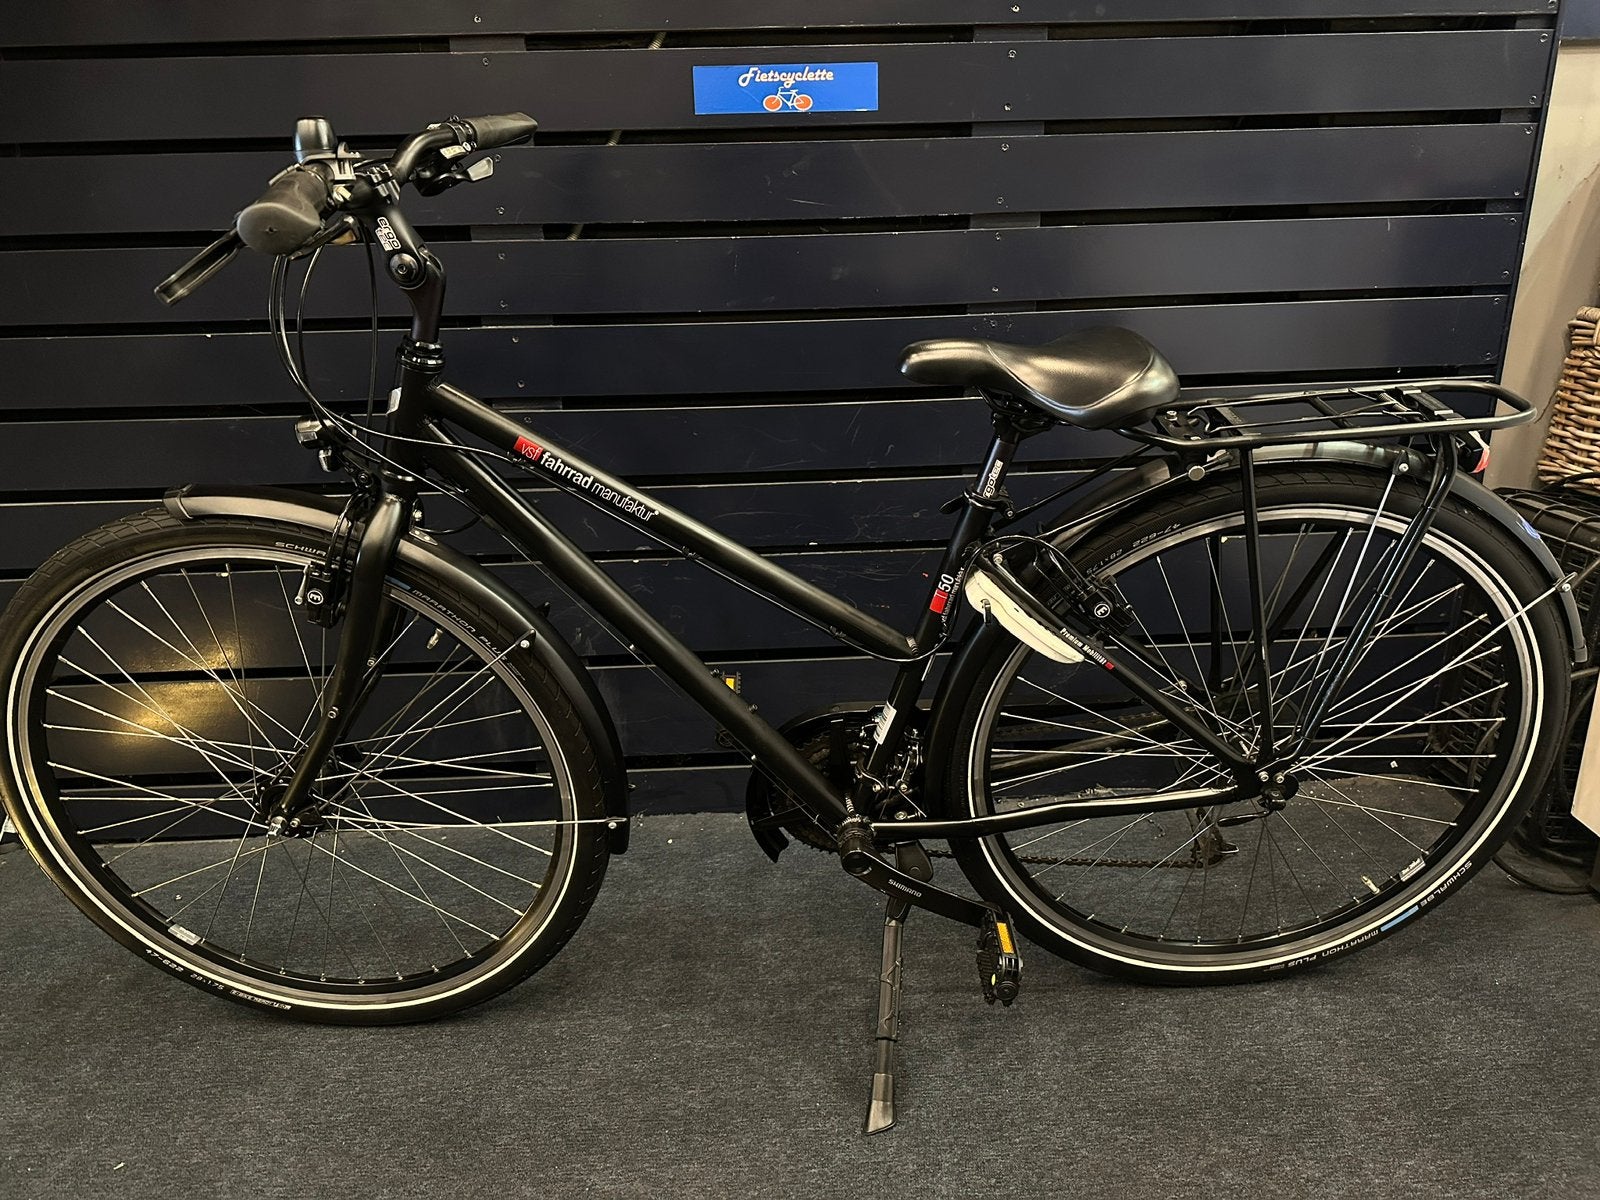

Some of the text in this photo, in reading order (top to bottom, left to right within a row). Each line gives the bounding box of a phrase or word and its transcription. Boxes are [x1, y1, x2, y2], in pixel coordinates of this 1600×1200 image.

[738, 66, 835, 88] Fietscyclette
[377, 216, 402, 249] ergo
[521, 443, 656, 522] vsf fahrrad manufaktur
[983, 459, 1004, 498] rgotec
[275, 541, 327, 557] SCHWA
[412, 589, 477, 633] MARATHON
[1060, 627, 1084, 648] Premium
[888, 878, 922, 898] SHIMANO
[1420, 860, 1473, 907] SCHWALBE
[1321, 929, 1379, 957] MARATHON
[145, 949, 185, 972] 47-622
[1287, 954, 1317, 968] PLUS
